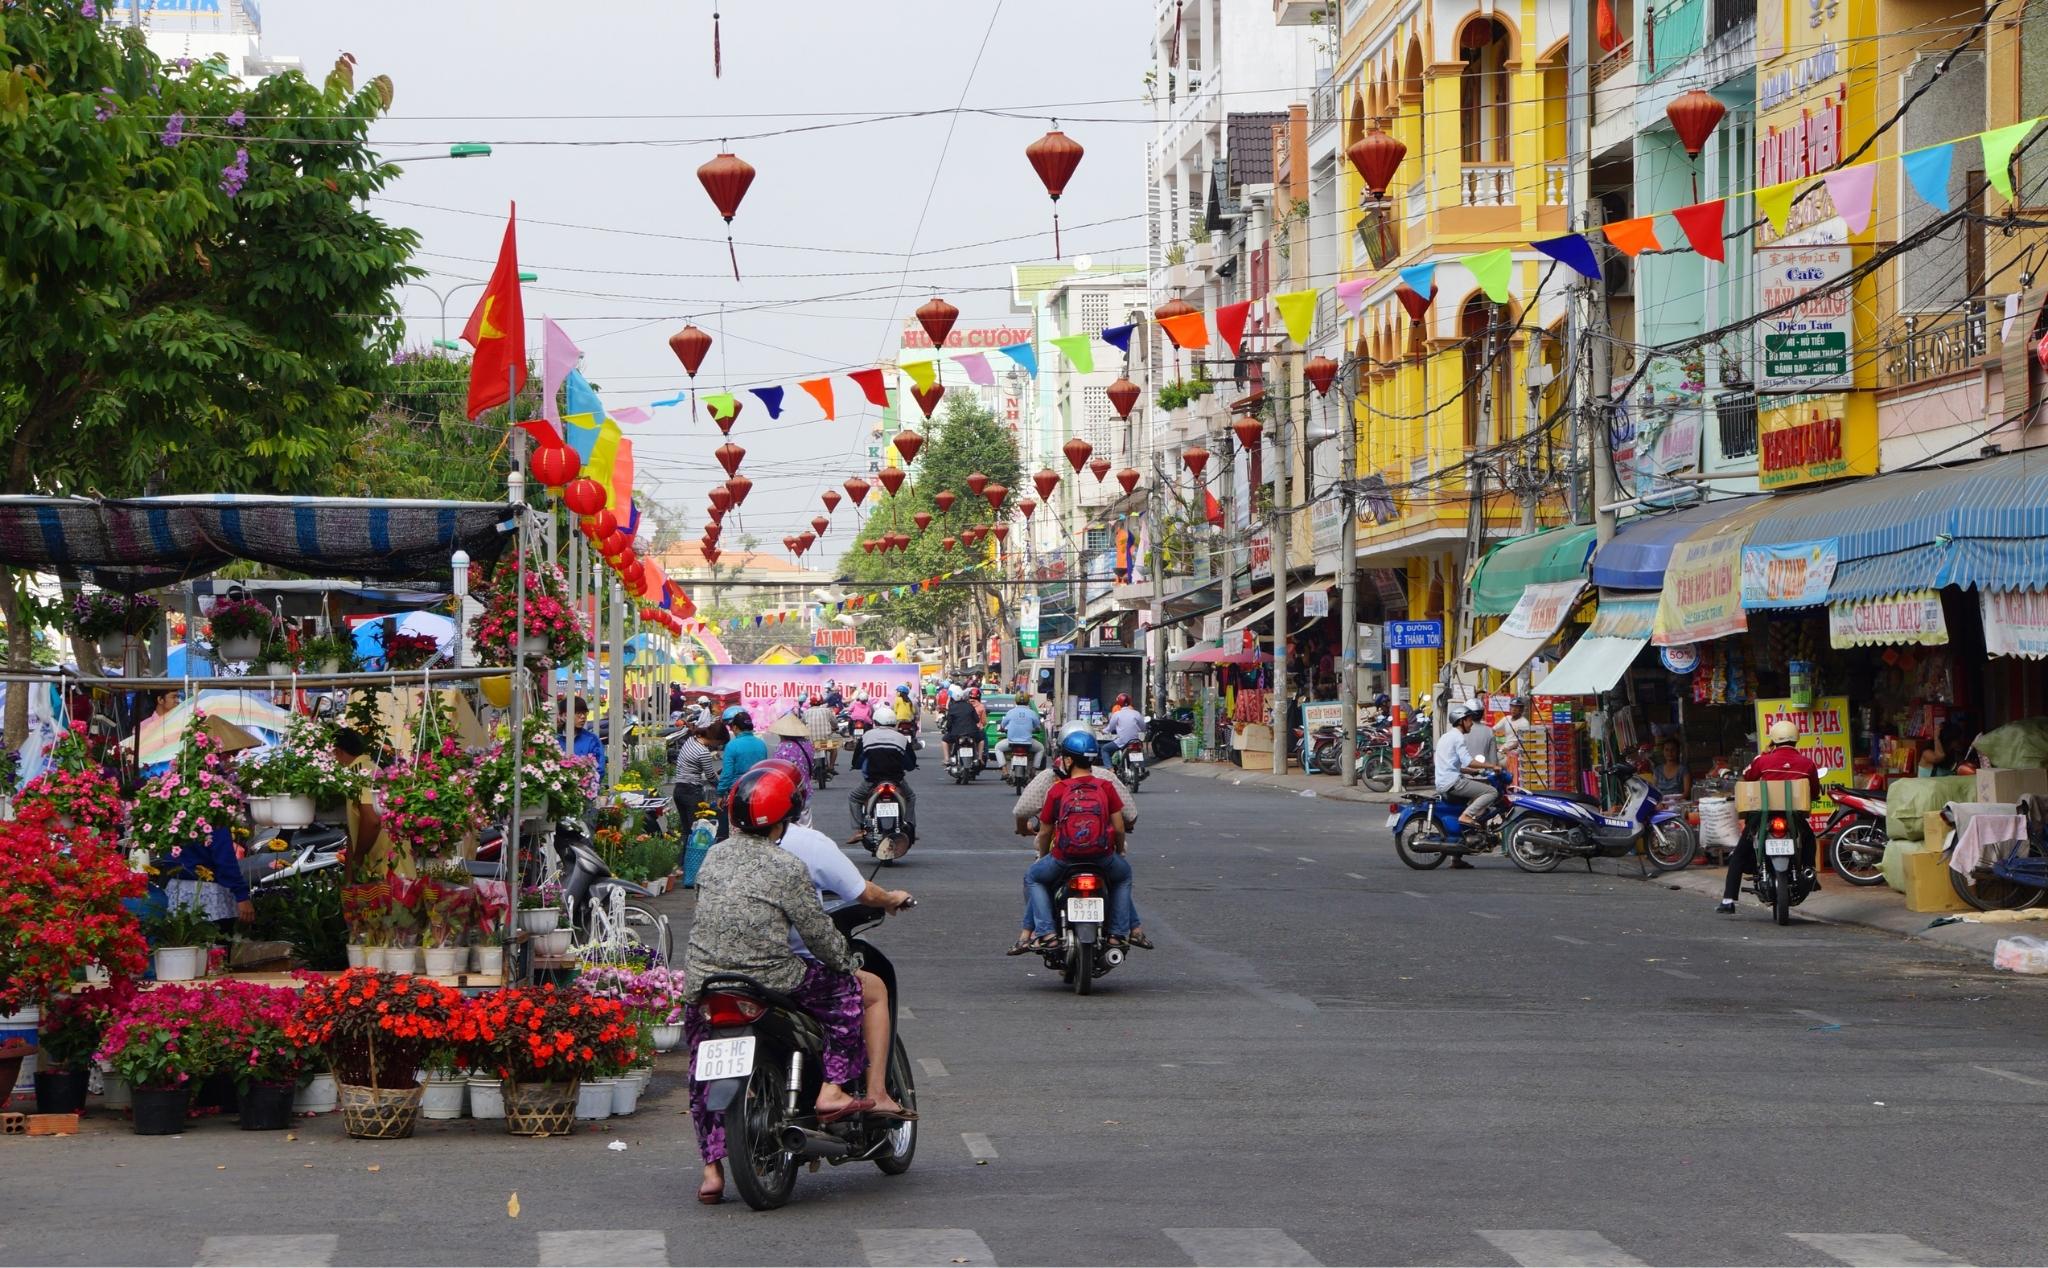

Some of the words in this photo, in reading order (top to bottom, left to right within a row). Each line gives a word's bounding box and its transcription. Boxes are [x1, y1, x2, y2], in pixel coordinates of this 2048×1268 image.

[968, 324, 1032, 347] CƯỜN
[836, 647, 865, 664] 2015
[744, 681, 778, 698] Chúc
[1604, 819, 1629, 828] YAMAHA
[705, 1058, 744, 1077] 0015
